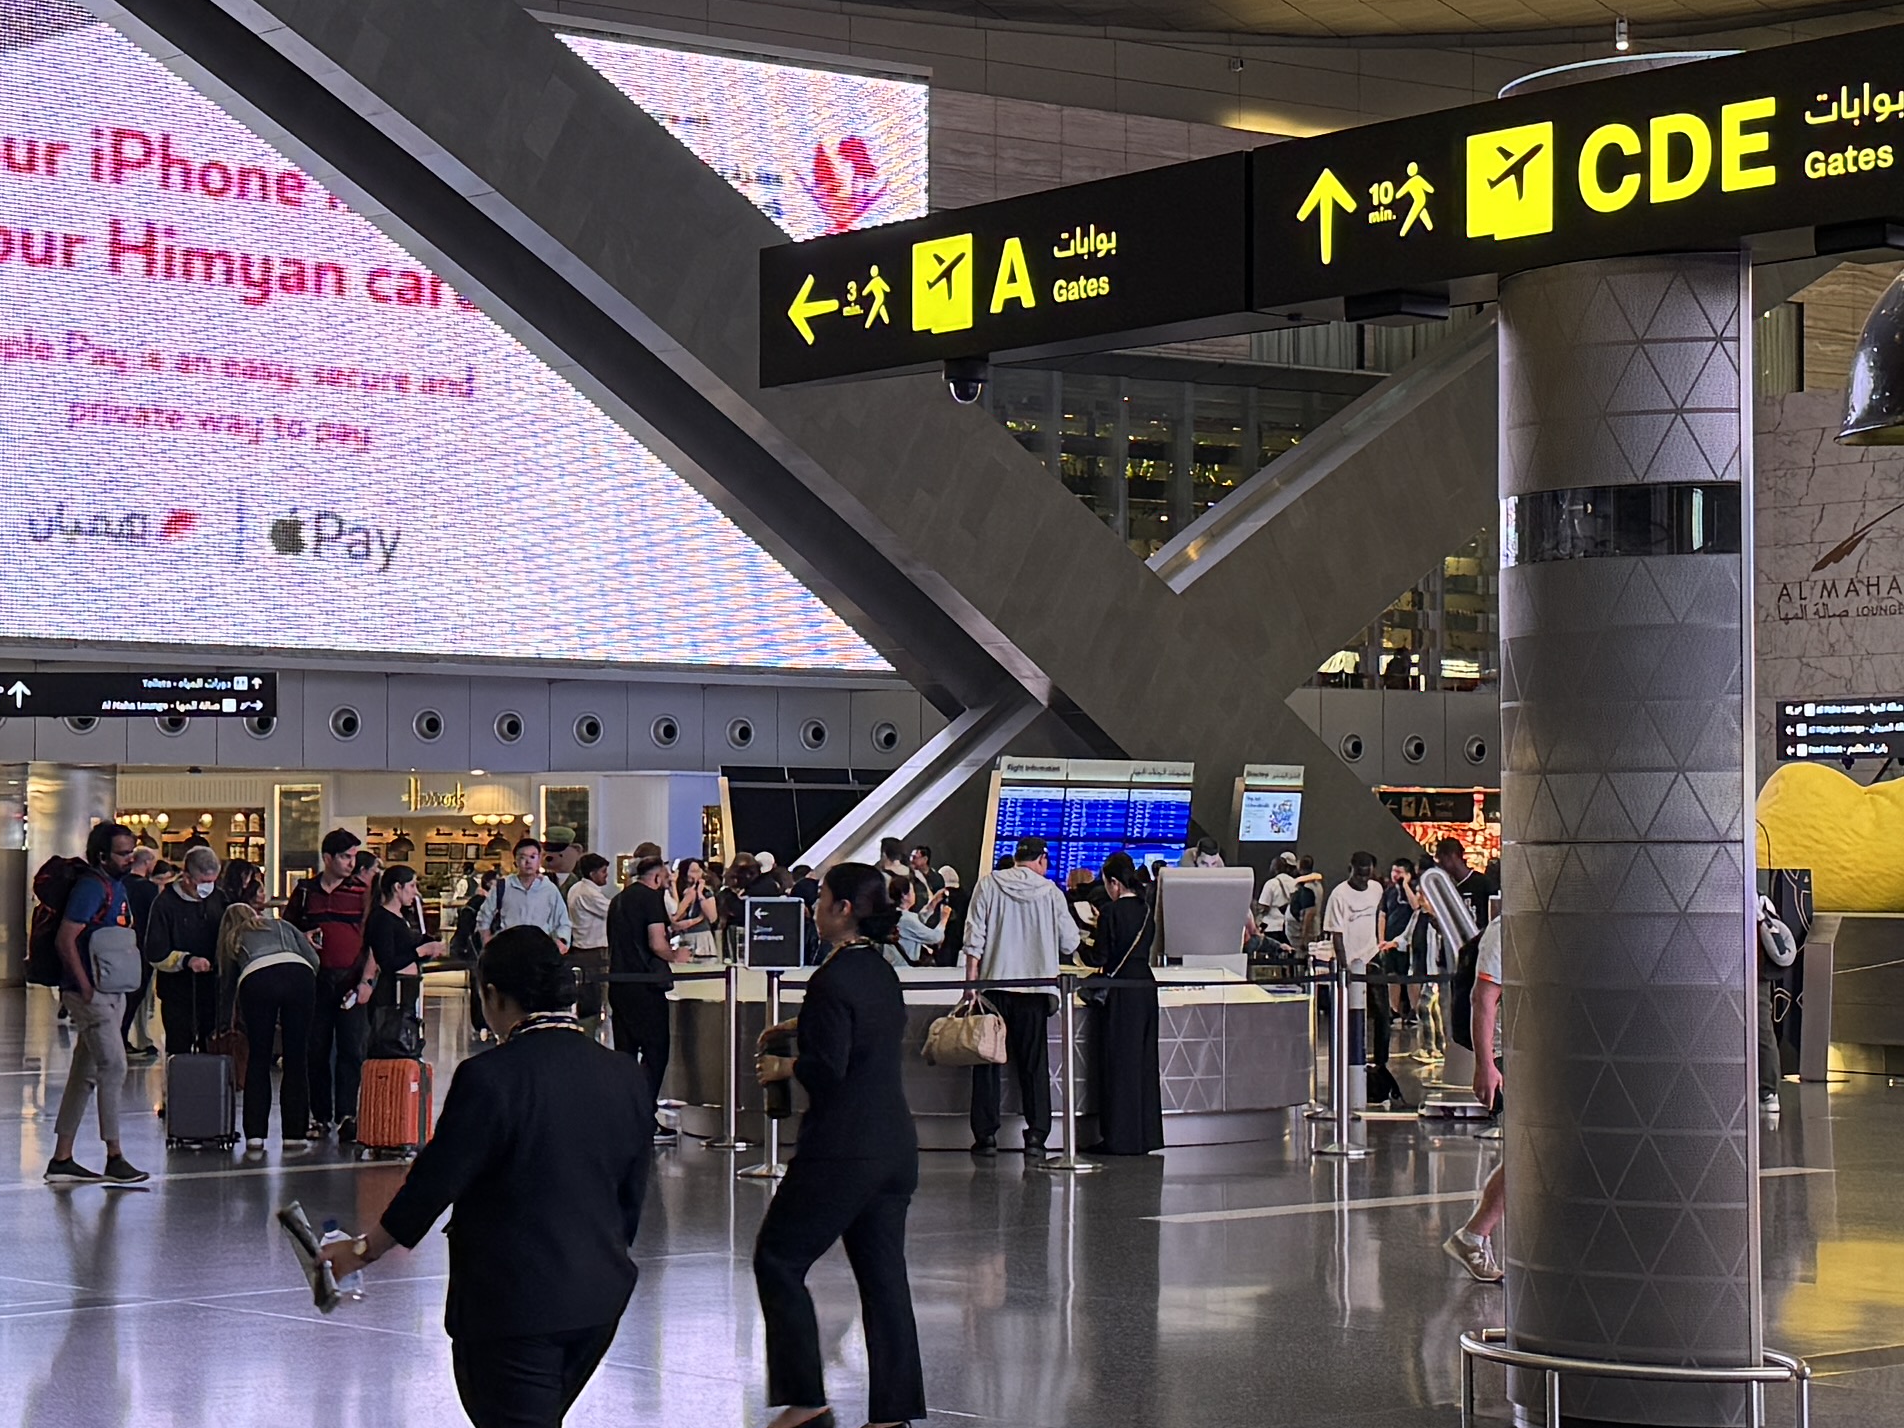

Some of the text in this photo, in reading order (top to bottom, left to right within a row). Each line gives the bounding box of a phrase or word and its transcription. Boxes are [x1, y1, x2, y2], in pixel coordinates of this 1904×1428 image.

[90, 126, 310, 207] iPhone
[1578, 96, 1776, 213] CDE
[1804, 141, 1895, 179] Gates
[1369, 181, 1394, 206] 10
[1369, 206, 1396, 224] min.
[1052, 223, 1117, 259] بوابات
[108, 217, 348, 305] Himyan
[989, 237, 1036, 313] A
[847, 281, 857, 302] 3
[1053, 275, 1110, 303] Gates
[67, 330, 127, 374] Pay
[175, 352, 213, 374] an
[314, 364, 413, 394] secure
[420, 363, 475, 399] and
[67, 401, 187, 429] private
[197, 413, 265, 444] way
[273, 413, 307, 440] to
[313, 509, 402, 573] Pay
[1778, 575, 1902, 603] AL MAHA
[1814, 602, 1849, 618] صالة
[1419, 797, 1431, 817] A
